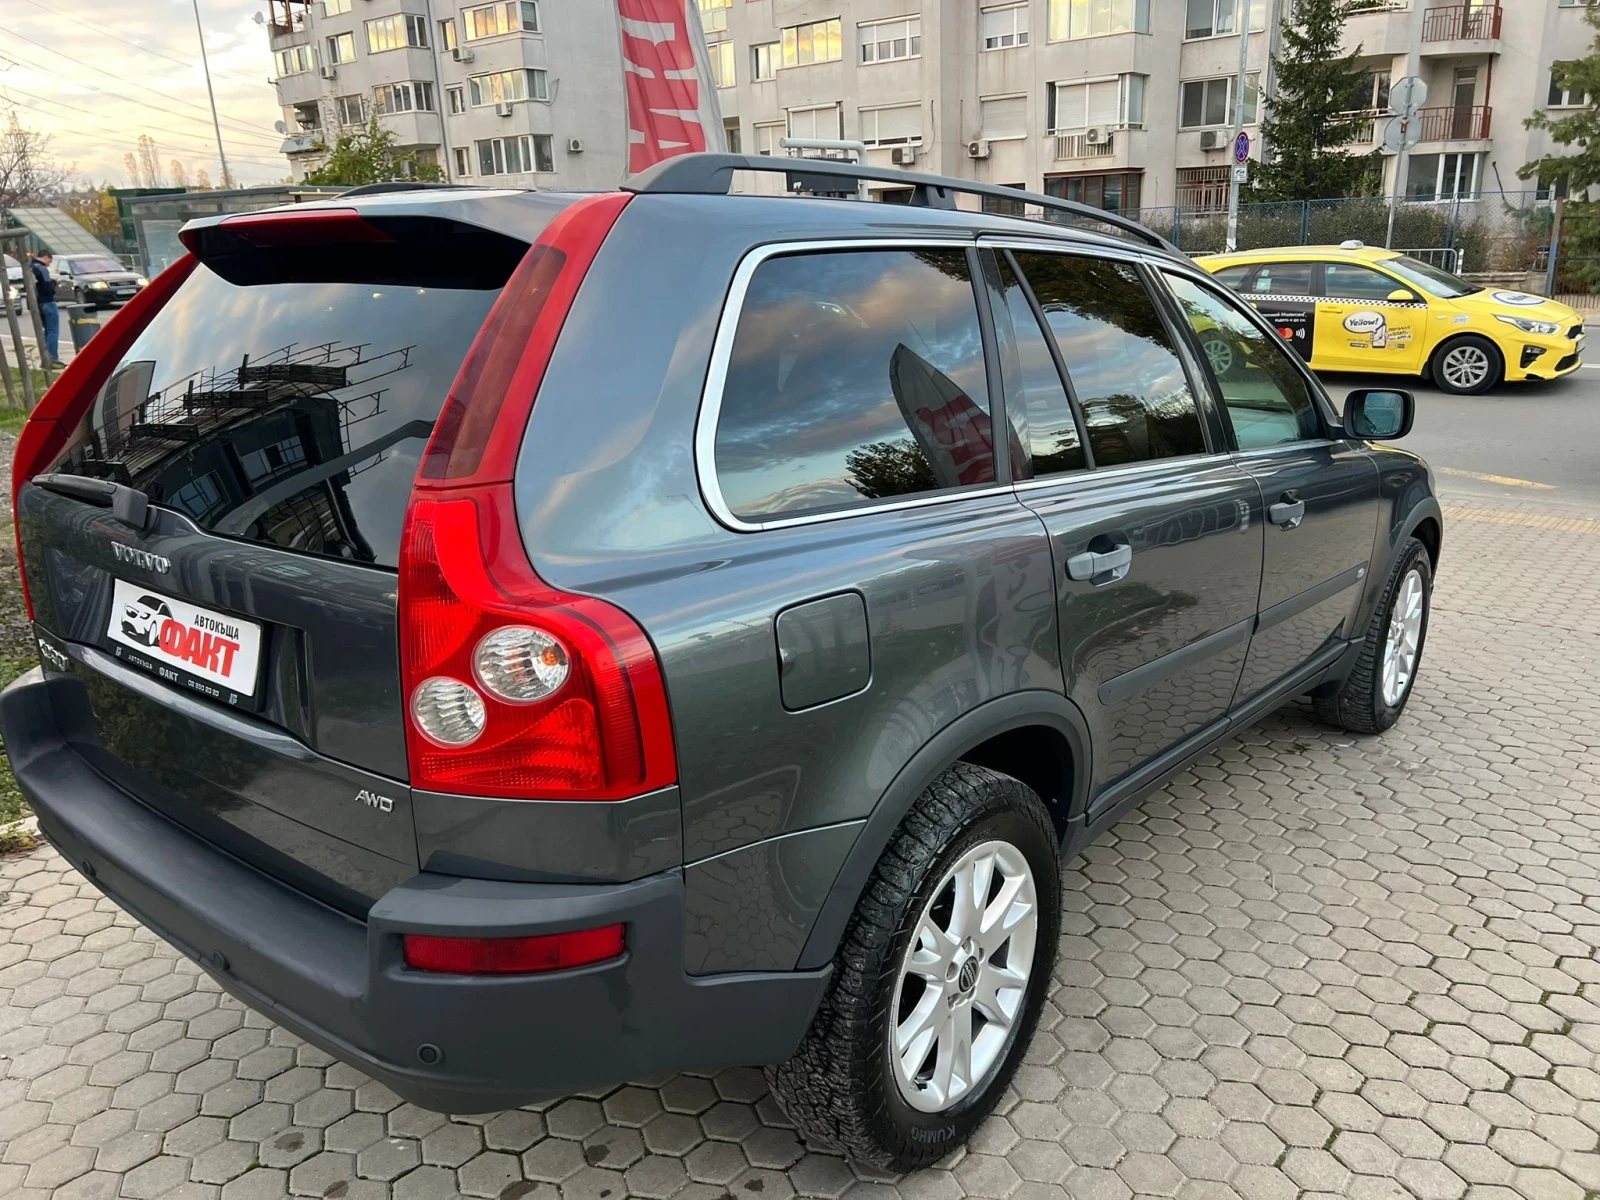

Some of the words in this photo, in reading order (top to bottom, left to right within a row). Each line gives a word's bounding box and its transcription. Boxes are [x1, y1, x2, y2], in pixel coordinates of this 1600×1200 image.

[1349, 317, 1379, 327] Yellow!
[111, 541, 171, 574] VOLVO
[194, 614, 239, 640] АВТОКЪЩА
[158, 618, 241, 678] ФАКТ
[158, 666, 179, 683] ФАКТ
[355, 789, 393, 812] AWD
[911, 1124, 956, 1144] KUMHO
